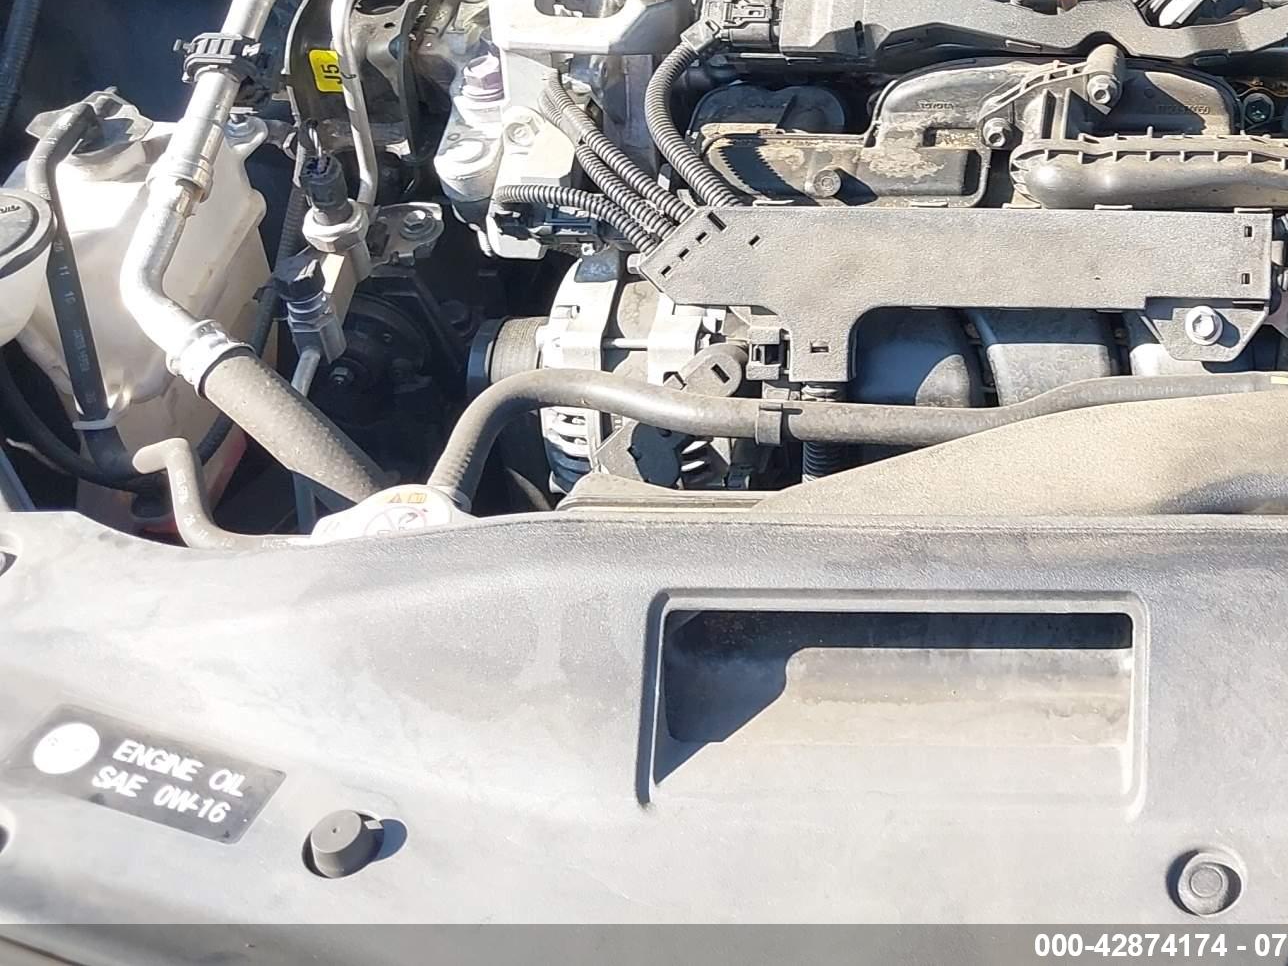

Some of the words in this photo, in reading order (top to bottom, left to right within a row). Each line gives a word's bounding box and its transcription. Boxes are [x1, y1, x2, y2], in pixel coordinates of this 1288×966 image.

[320, 64, 343, 85] J5
[91, 766, 148, 797] SAE
[153, 785, 231, 823] 0W-16
[112, 739, 204, 781] ENGINE
[208, 769, 246, 797] OIL
